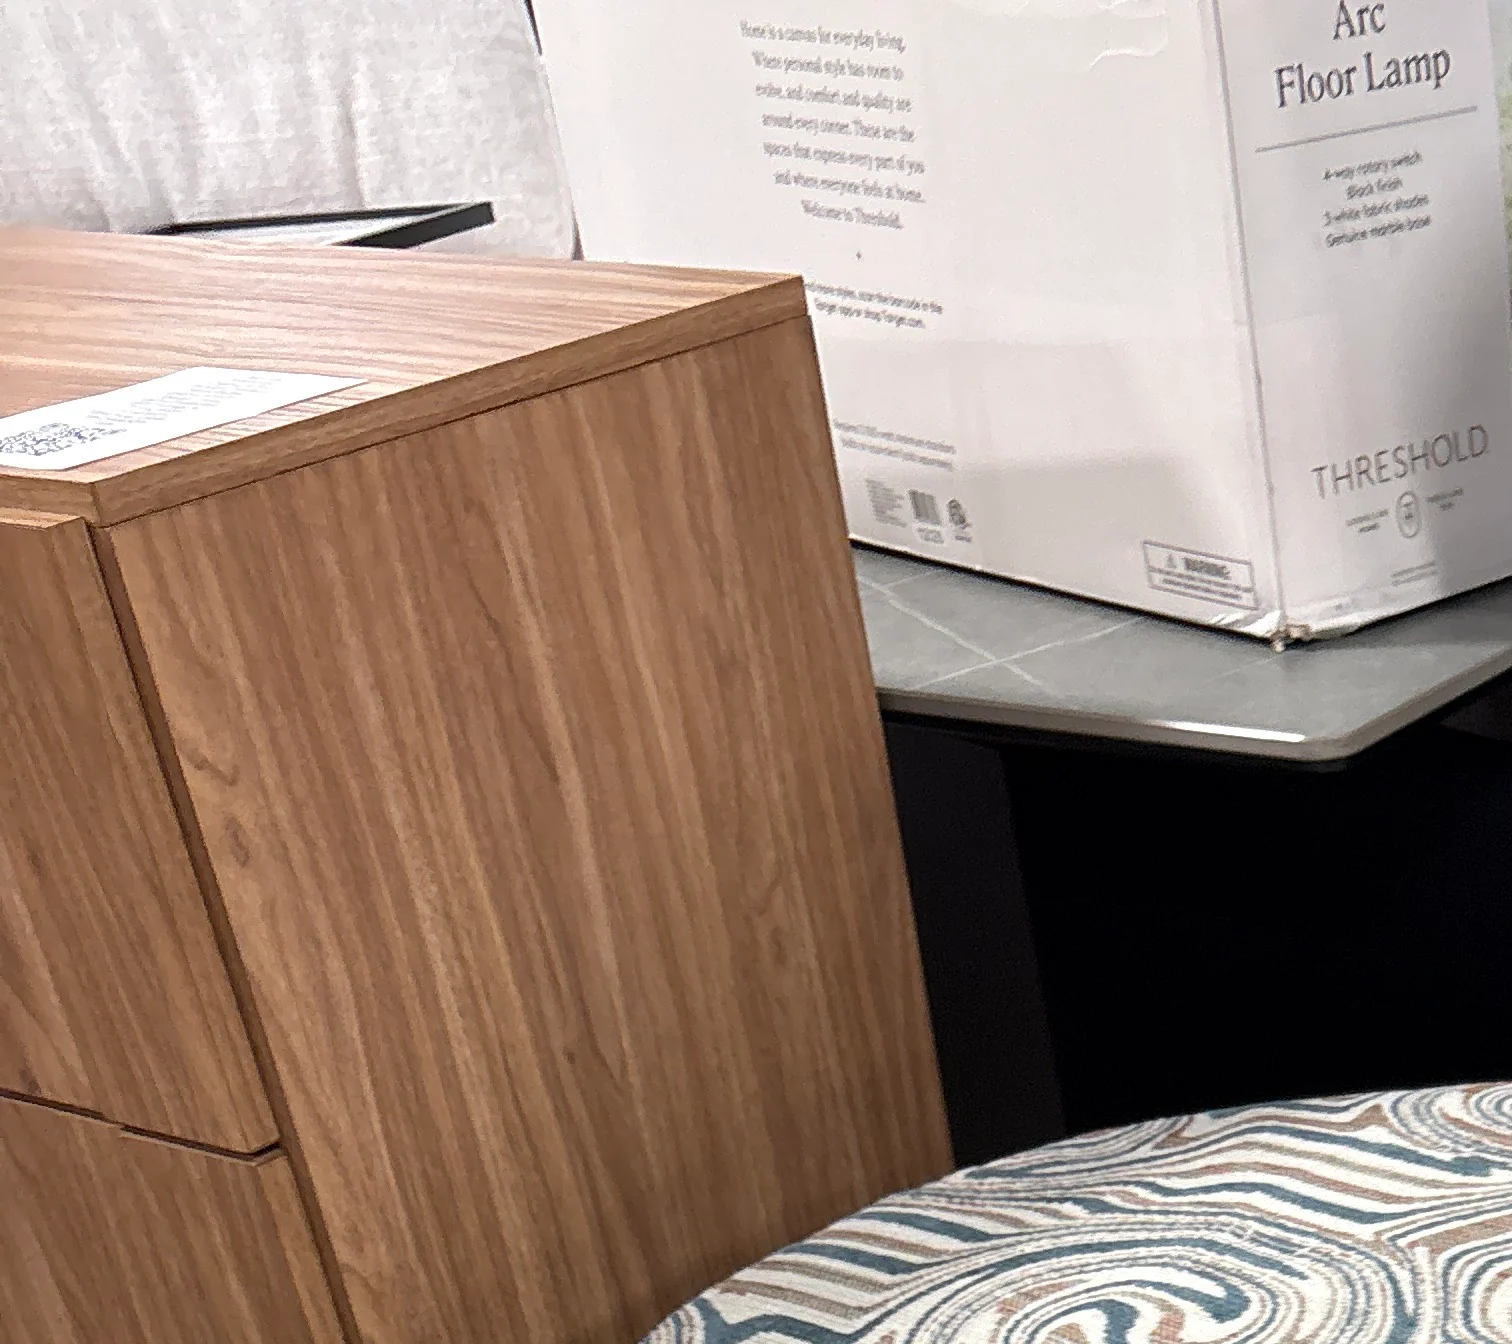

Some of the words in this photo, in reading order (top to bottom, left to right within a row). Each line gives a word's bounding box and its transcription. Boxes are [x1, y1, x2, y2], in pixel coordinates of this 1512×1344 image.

[1333, 0, 1386, 40] Arc
[1275, 62, 1357, 108] Floor
[1364, 49, 1450, 92] Lamp
[1311, 424, 1490, 499] THRESHOLD
